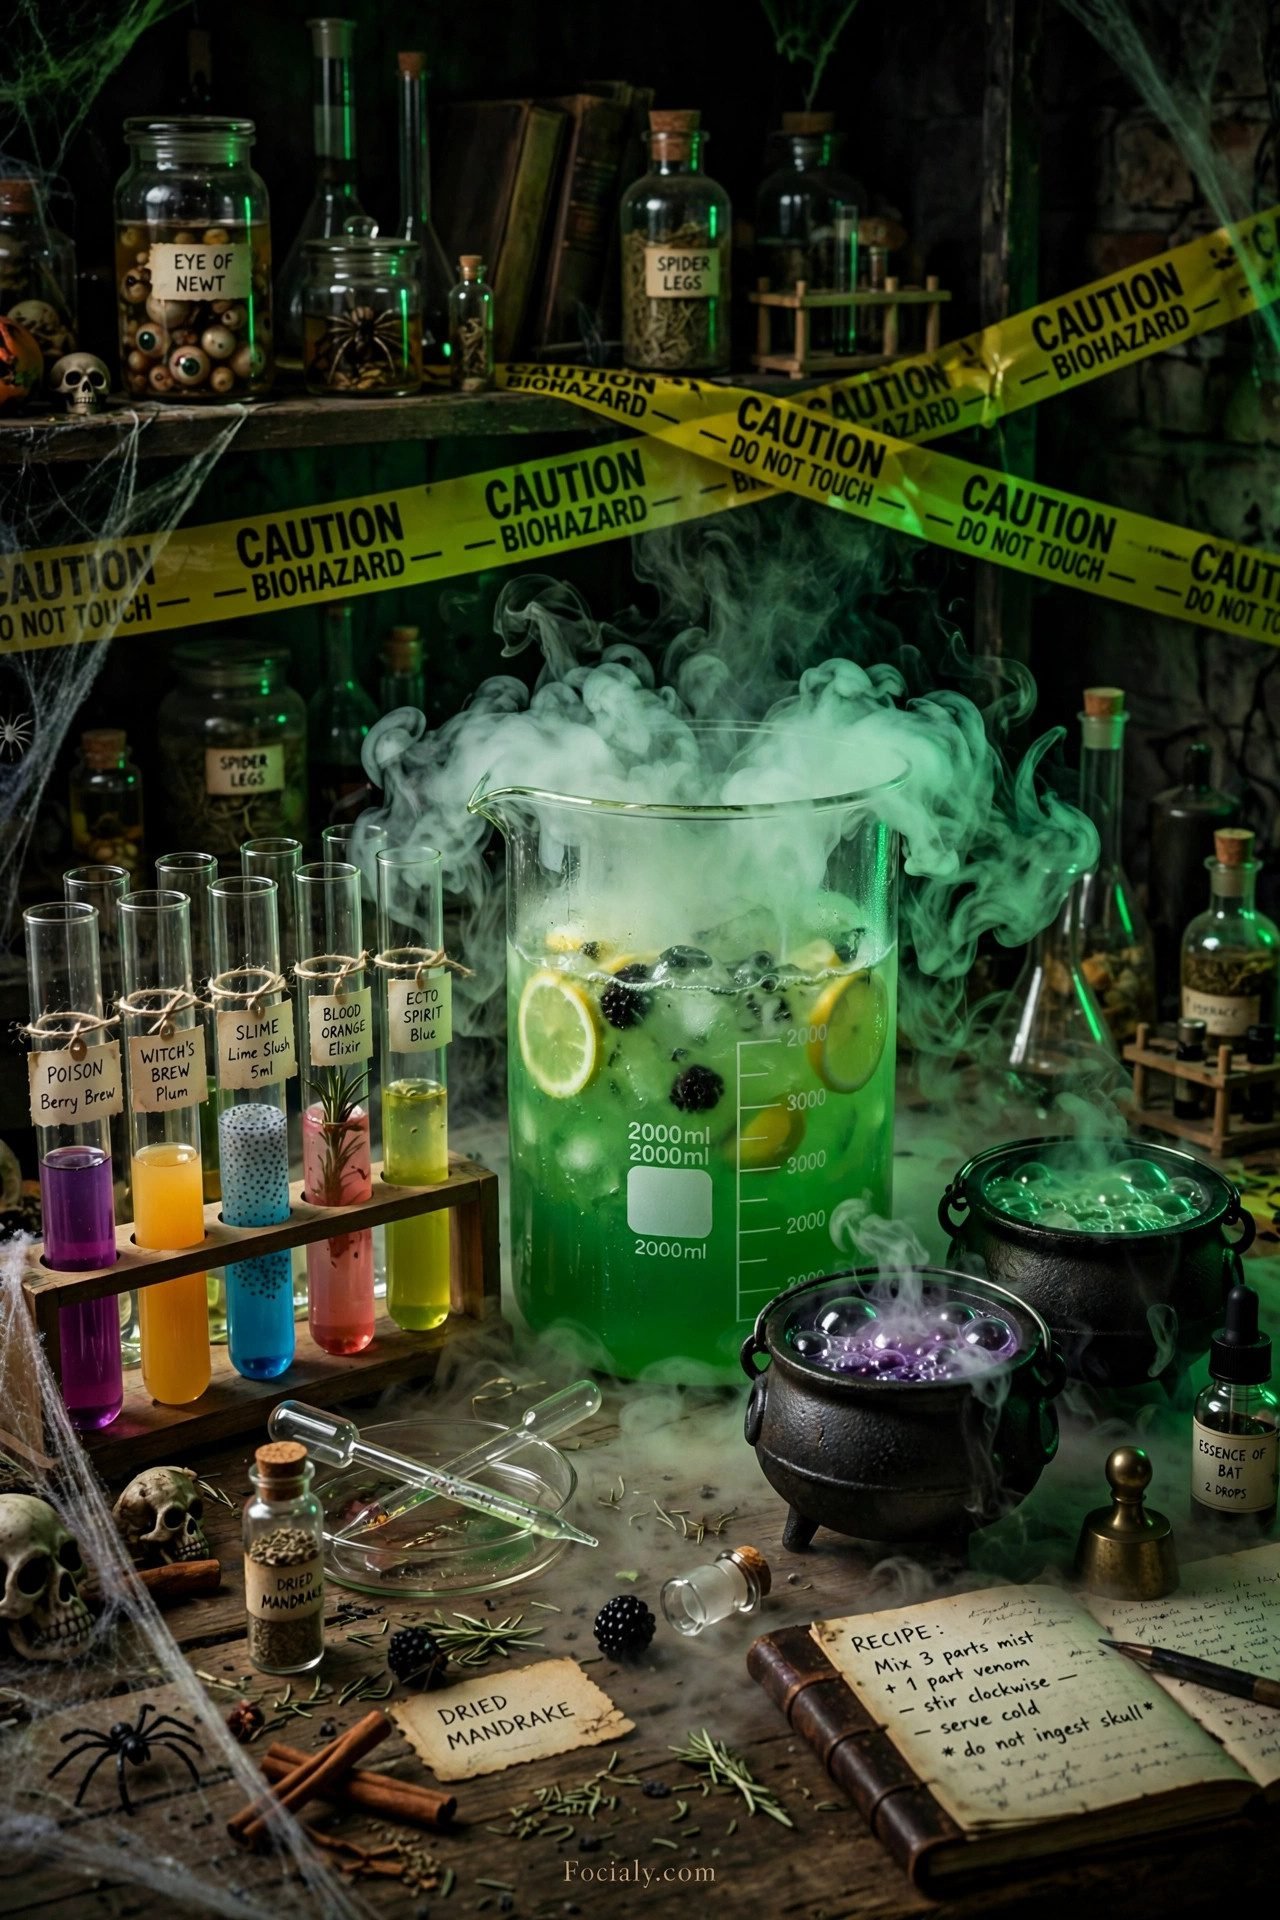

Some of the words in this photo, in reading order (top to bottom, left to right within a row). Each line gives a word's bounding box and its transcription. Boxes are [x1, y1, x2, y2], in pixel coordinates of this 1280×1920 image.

[175, 254, 206, 270] EYE
[213, 252, 234, 270] OF
[657, 256, 711, 272] SPIDER
[176, 275, 226, 292] NEWT
[663, 275, 702, 291] LEGS
[1031, 261, 1184, 352] CAUTION
[1051, 304, 1190, 381] BIOHAZARD
[505, 364, 656, 395] CAUTION
[506, 375, 648, 419] BIOHAZARD
[872, 397, 960, 437] AZARD
[737, 395, 887, 480] CAUTION
[729, 434, 759, 465] DO
[762, 446, 806, 482] NOT
[807, 462, 875, 508] TOUCH
[485, 447, 647, 521] CAUTION
[499, 494, 648, 553] BIOHAZARD
[962, 474, 1118, 554] CAUTION
[236, 501, 405, 569] CAUTION
[956, 515, 988, 546] DO
[990, 527, 1036, 561] NOT
[1037, 541, 1105, 584] TOUCH
[251, 548, 406, 603] BIOHAZARD
[1191, 543, 1280, 605] CAUT
[21, 605, 66, 639] NOT
[73, 592, 152, 628] TOUCH
[1184, 585, 1215, 614] DO
[1217, 595, 1259, 627] NOT
[220, 753, 269, 770] SPIDER
[230, 770, 265, 788] LEGS
[406, 989, 439, 1006] ECTO
[323, 1003, 362, 1022] BLOOD
[403, 1005, 444, 1024] SPIRIT
[236, 1018, 279, 1041] SLIME
[321, 1019, 366, 1039] ORANGE
[410, 1027, 437, 1043] Blue
[786, 1024, 828, 1048] 2000
[140, 1040, 195, 1064] WITCH'S
[228, 1047, 257, 1061] Lime
[263, 1040, 291, 1057] Slush
[328, 1040, 360, 1057] Elixir
[48, 1059, 103, 1084] POISON
[151, 1062, 190, 1083] BREW
[250, 1060, 273, 1079] 5ml
[41, 1093, 78, 1114] Berry
[85, 1087, 115, 1106] Brew
[156, 1086, 188, 1102] Plum
[786, 1088, 826, 1111] 3000
[628, 1121, 711, 1145] 2000ml
[629, 1144, 710, 1166] 2000ml
[786, 1150, 826, 1175] 3000
[786, 1210, 826, 1235] 2000
[634, 1239, 707, 1260] 2000ml
[1199, 1439, 1246, 1461] ESSENCE
[1252, 1447, 1267, 1460] OF
[1218, 1464, 1243, 1480] BAT
[1205, 1482, 1211, 1492] 2
[1215, 1485, 1247, 1499] DROPS
[277, 1572, 313, 1591] DRIED
[875, 1658, 913, 1676] Mix
[919, 1650, 934, 1668] 3
[942, 1640, 989, 1666] parts
[996, 1630, 1035, 1650] mist
[906, 1677, 918, 1691] 1
[926, 1667, 964, 1692] part
[973, 1656, 1031, 1677] venom
[924, 1694, 958, 1714] stir
[967, 1675, 1051, 1705] clockwise
[437, 1694, 509, 1727] DRIED
[940, 1713, 993, 1735] serve
[1001, 1699, 1041, 1722] cold
[446, 1701, 576, 1751] MANDRAKE
[963, 1740, 986, 1758] do
[995, 1730, 1026, 1751] not
[1036, 1716, 1091, 1745] ingest
